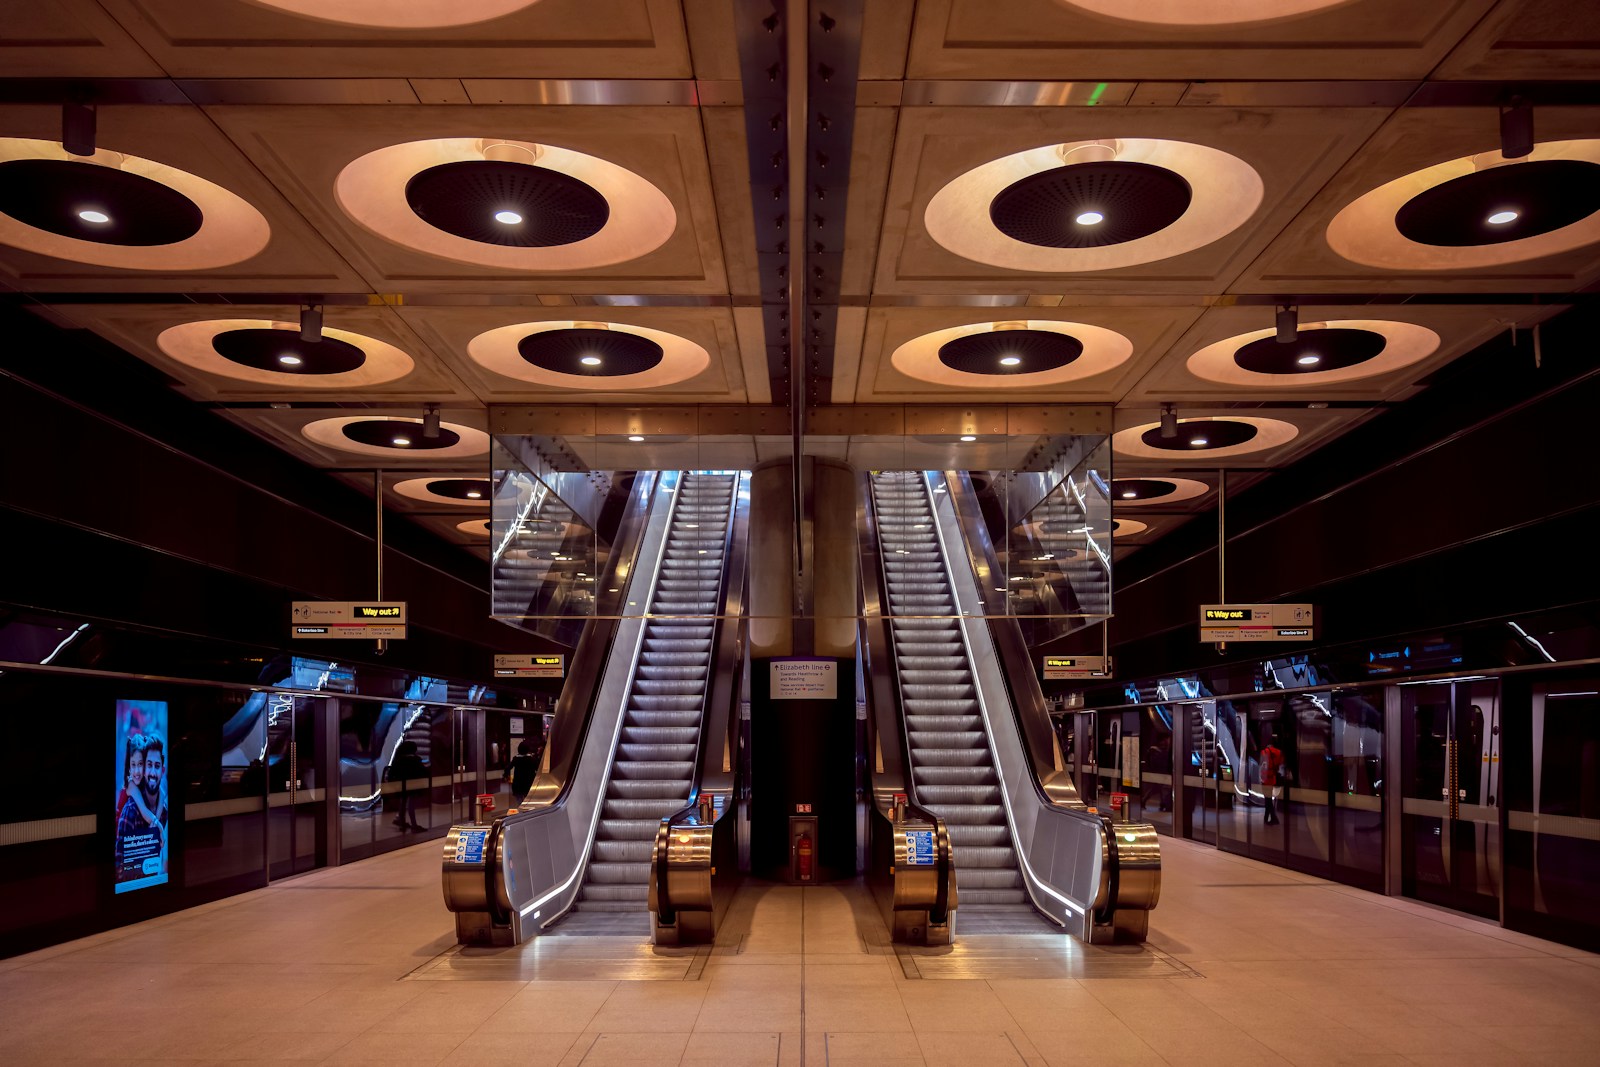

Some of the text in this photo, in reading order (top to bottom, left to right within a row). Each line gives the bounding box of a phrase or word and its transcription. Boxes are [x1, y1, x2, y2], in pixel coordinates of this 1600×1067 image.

[362, 607, 393, 617] Way out
[1214, 610, 1230, 619] Way
